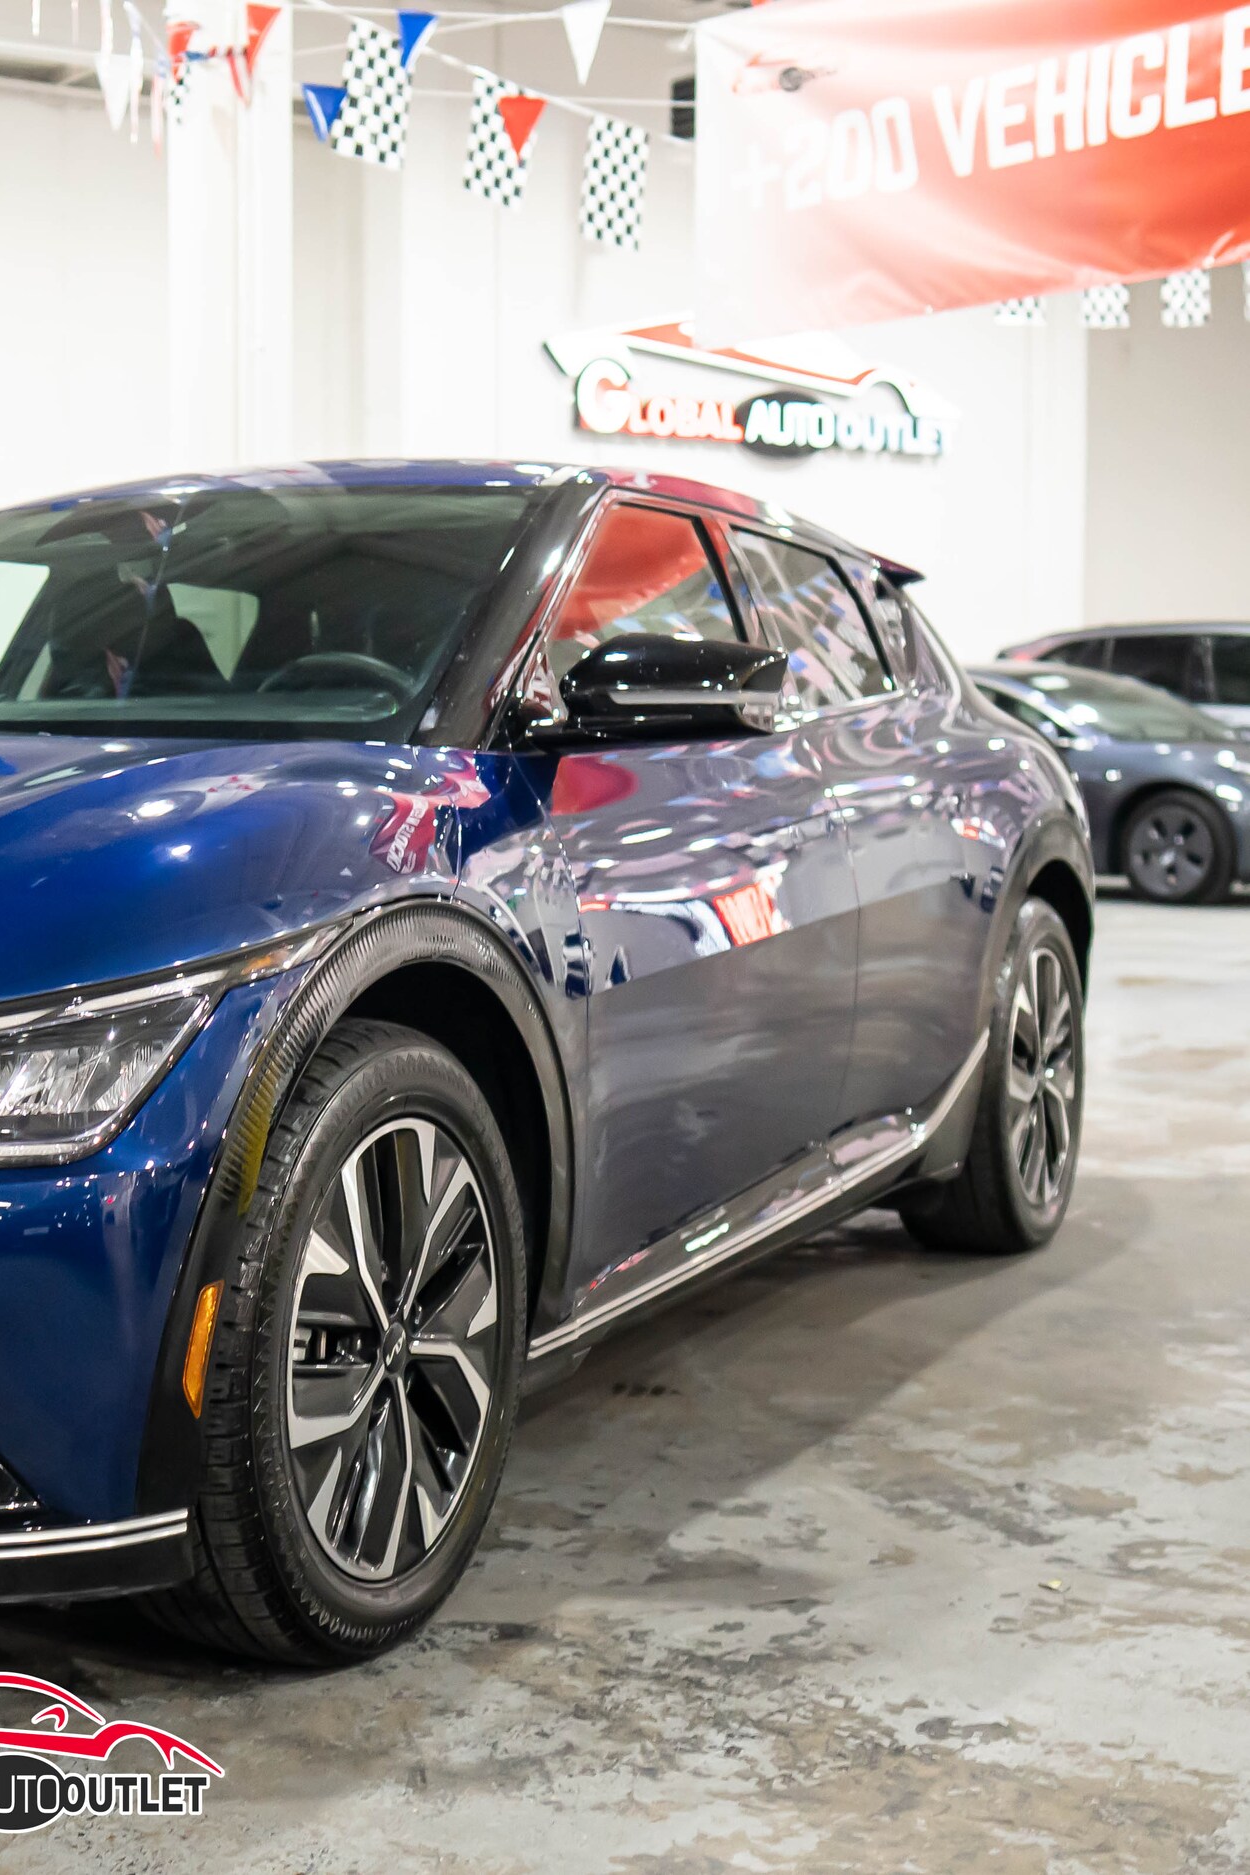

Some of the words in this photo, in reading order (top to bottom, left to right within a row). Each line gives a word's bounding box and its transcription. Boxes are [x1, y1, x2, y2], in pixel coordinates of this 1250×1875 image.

[730, 97, 919, 210] +200
[576, 357, 744, 442] GLOBAL
[745, 398, 836, 450] AUTO
